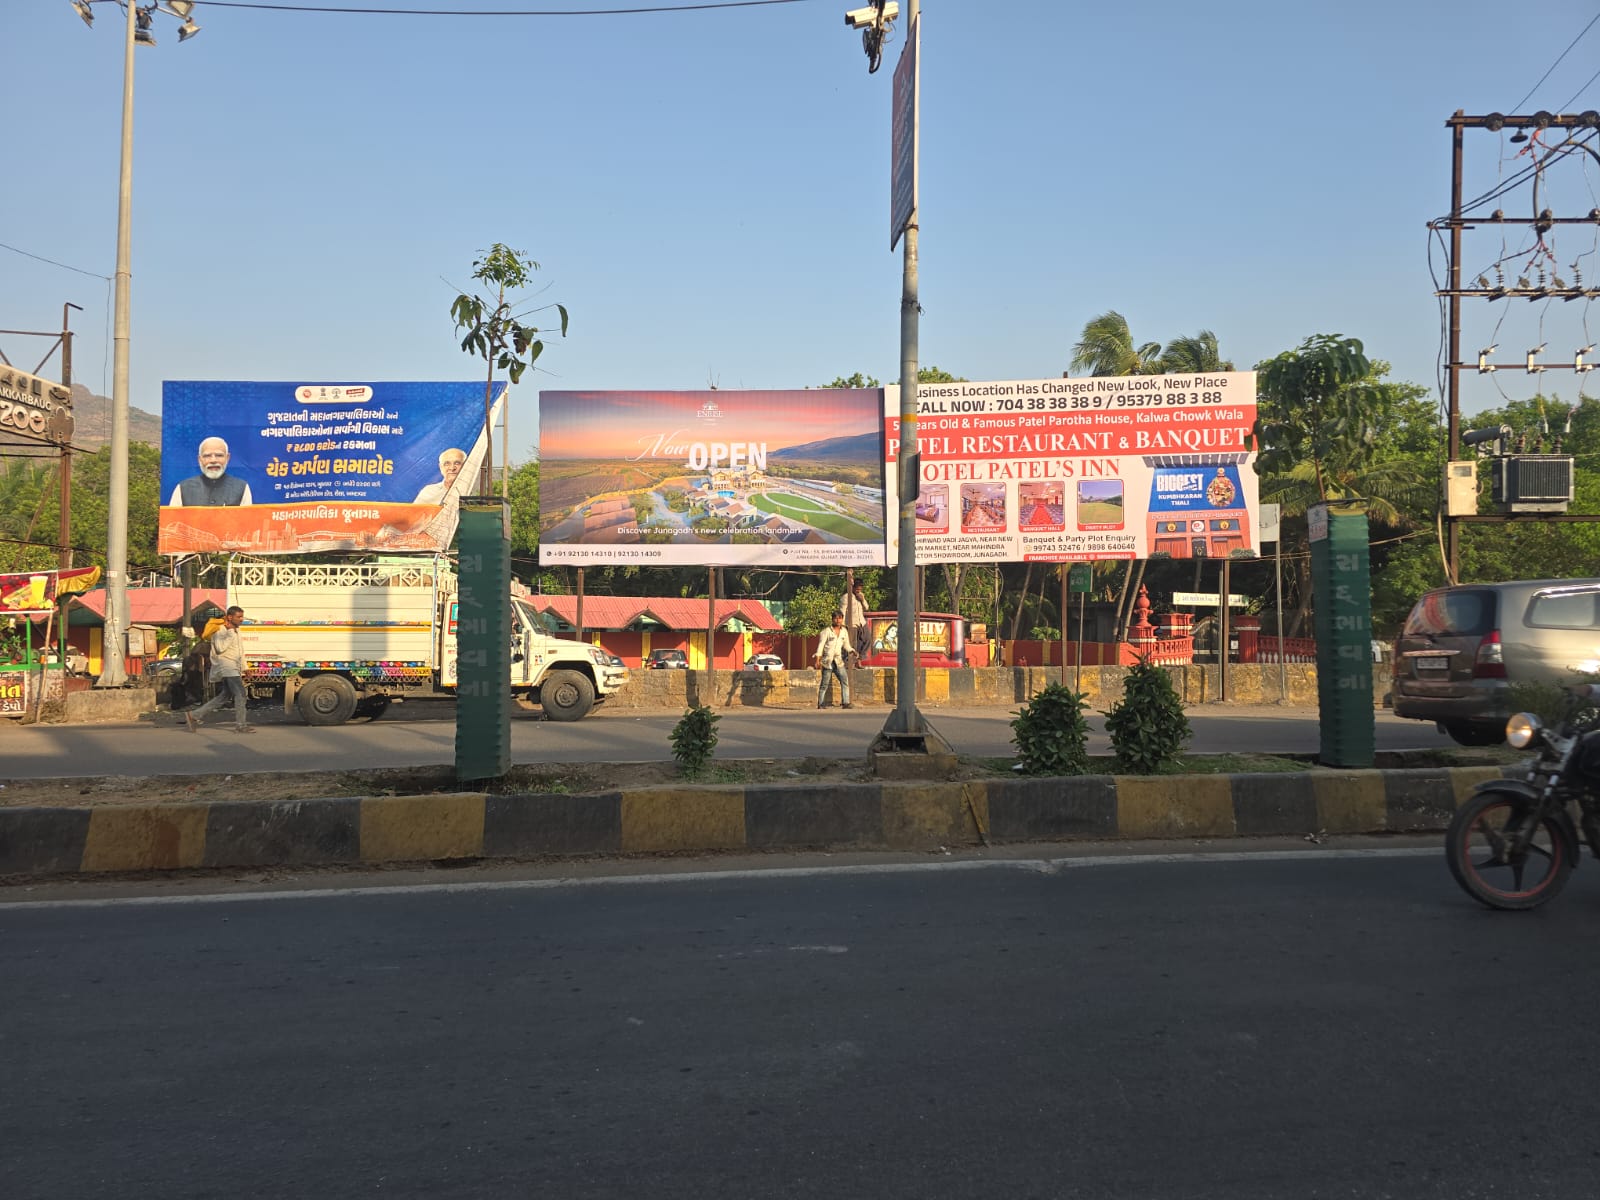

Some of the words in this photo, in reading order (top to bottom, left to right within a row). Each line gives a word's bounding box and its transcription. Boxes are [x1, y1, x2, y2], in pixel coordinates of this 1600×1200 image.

[916, 387, 959, 398] usiness
[962, 384, 1014, 396] Location
[1016, 384, 1038, 395] Has
[1041, 381, 1094, 396] Changed
[1098, 380, 1126, 392] New
[1128, 378, 1161, 392] Look,
[1164, 378, 1192, 390] New
[1194, 377, 1228, 388] Place
[951, 400, 986, 412] NOW
[996, 399, 1024, 411] 704
[1028, 398, 1046, 410] 38
[1049, 397, 1068, 409] 38
[1071, 396, 1088, 408] 38
[1092, 396, 1102, 408] 9
[1117, 394, 1162, 407] 95379
[1166, 393, 1186, 405] 88
[1190, 393, 1198, 404] 3
[1202, 392, 1222, 404] 88
[916, 420, 937, 430] ears
[940, 418, 958, 430] Old
[962, 418, 970, 428] &
[974, 417, 1016, 428] Famous
[1018, 416, 1046, 427] Patel
[1050, 414, 1092, 426] Parotha
[1095, 414, 1133, 425] House,
[1136, 412, 1170, 424] Kalwa
[1173, 410, 1212, 422] Chowk
[1215, 410, 1244, 420] Wala
[625, 429, 689, 462] Now
[689, 442, 767, 471] OPEN
[888, 437, 957, 456] PTEL
[962, 432, 1114, 454] RESTAURANT
[1118, 436, 1130, 449] &
[1136, 428, 1249, 450] BANQUET
[266, 457, 289, 477] ચેક
[333, 454, 394, 474] સમારોહ
[920, 462, 982, 482] OTEL
[988, 460, 1074, 480] PATEL'S
[1082, 458, 1120, 477] INN
[1156, 474, 1204, 492] BIGGEST
[618, 527, 651, 535] Discover
[654, 527, 698, 536] Junagadh's
[1066, 536, 1086, 544] Party
[1106, 534, 1136, 542] Enquiry
[920, 622, 946, 635] HIV
